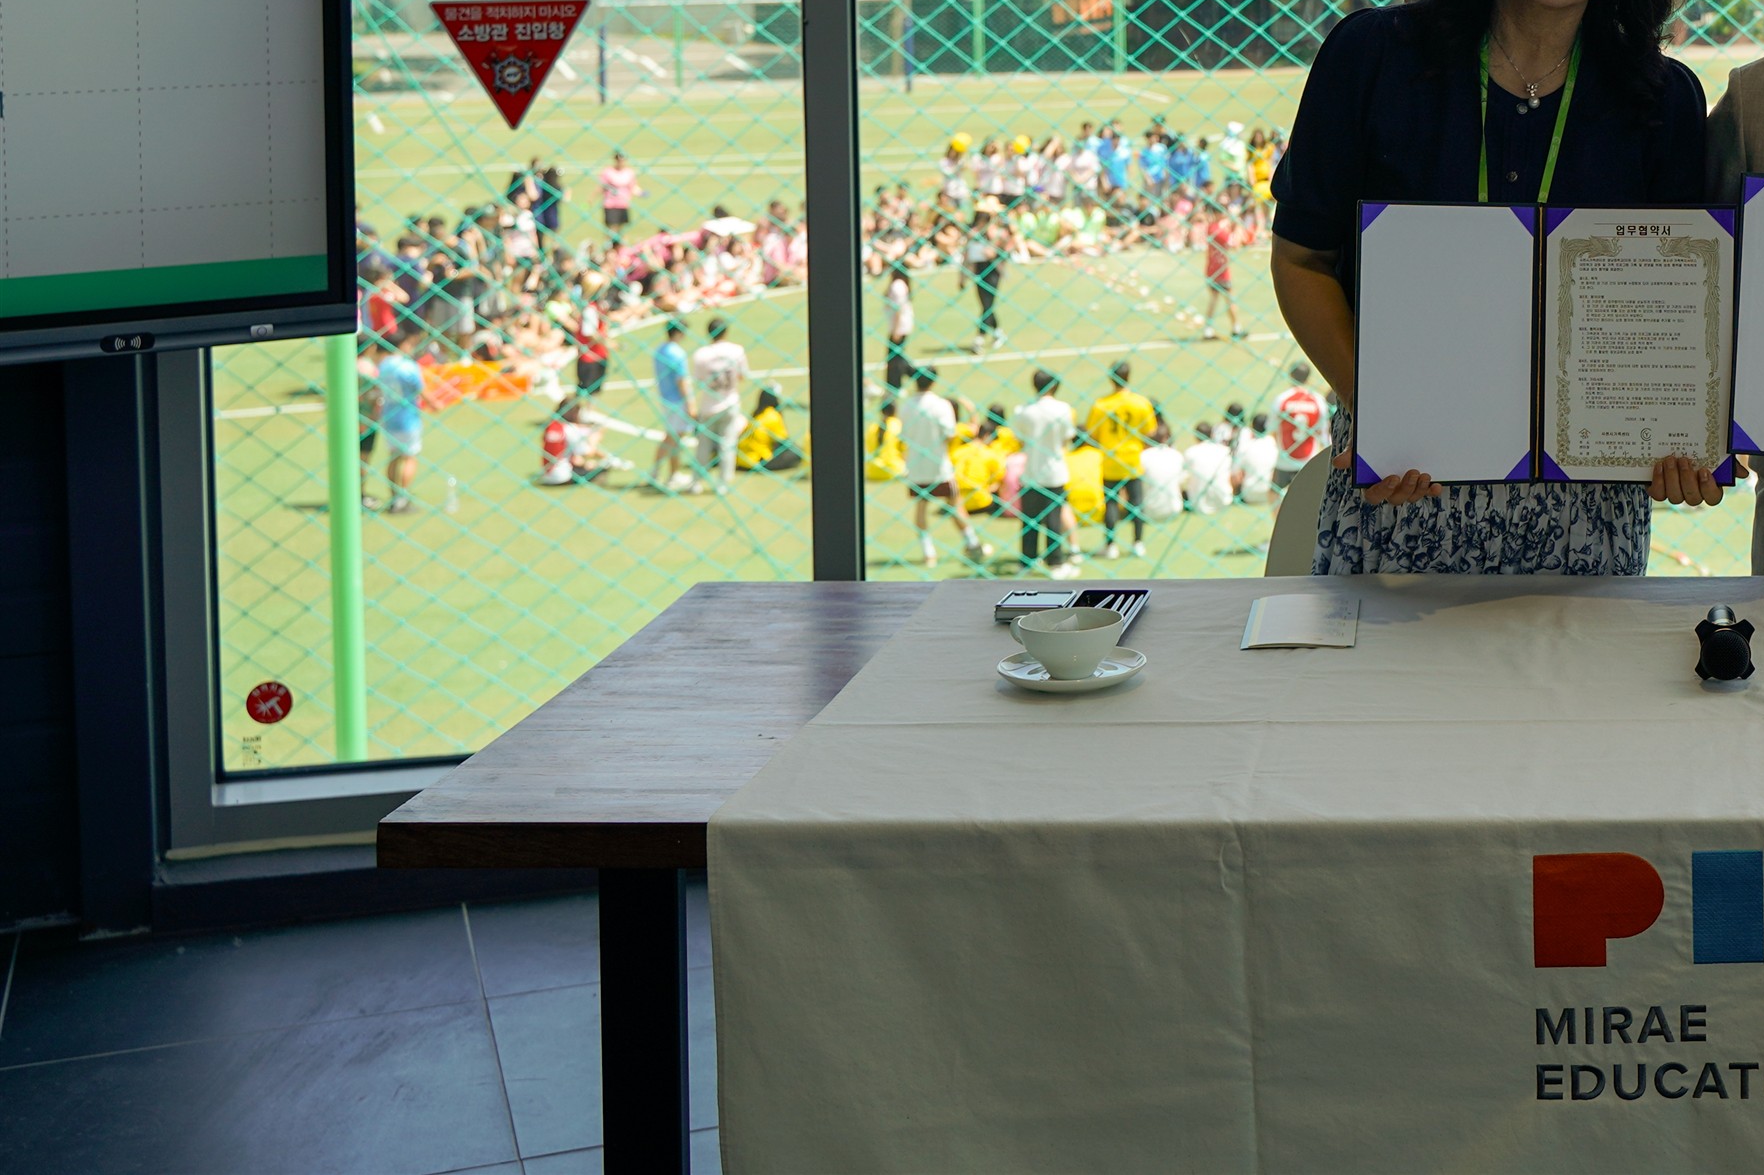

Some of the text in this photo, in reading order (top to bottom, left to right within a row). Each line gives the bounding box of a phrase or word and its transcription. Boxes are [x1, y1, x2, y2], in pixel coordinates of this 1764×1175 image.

[538, 4, 577, 18] 마시오
[457, 21, 566, 42] 소방관 진입창
[1615, 225, 1671, 236] 업무협약서
[1535, 1004, 1708, 1046] MIRAE
